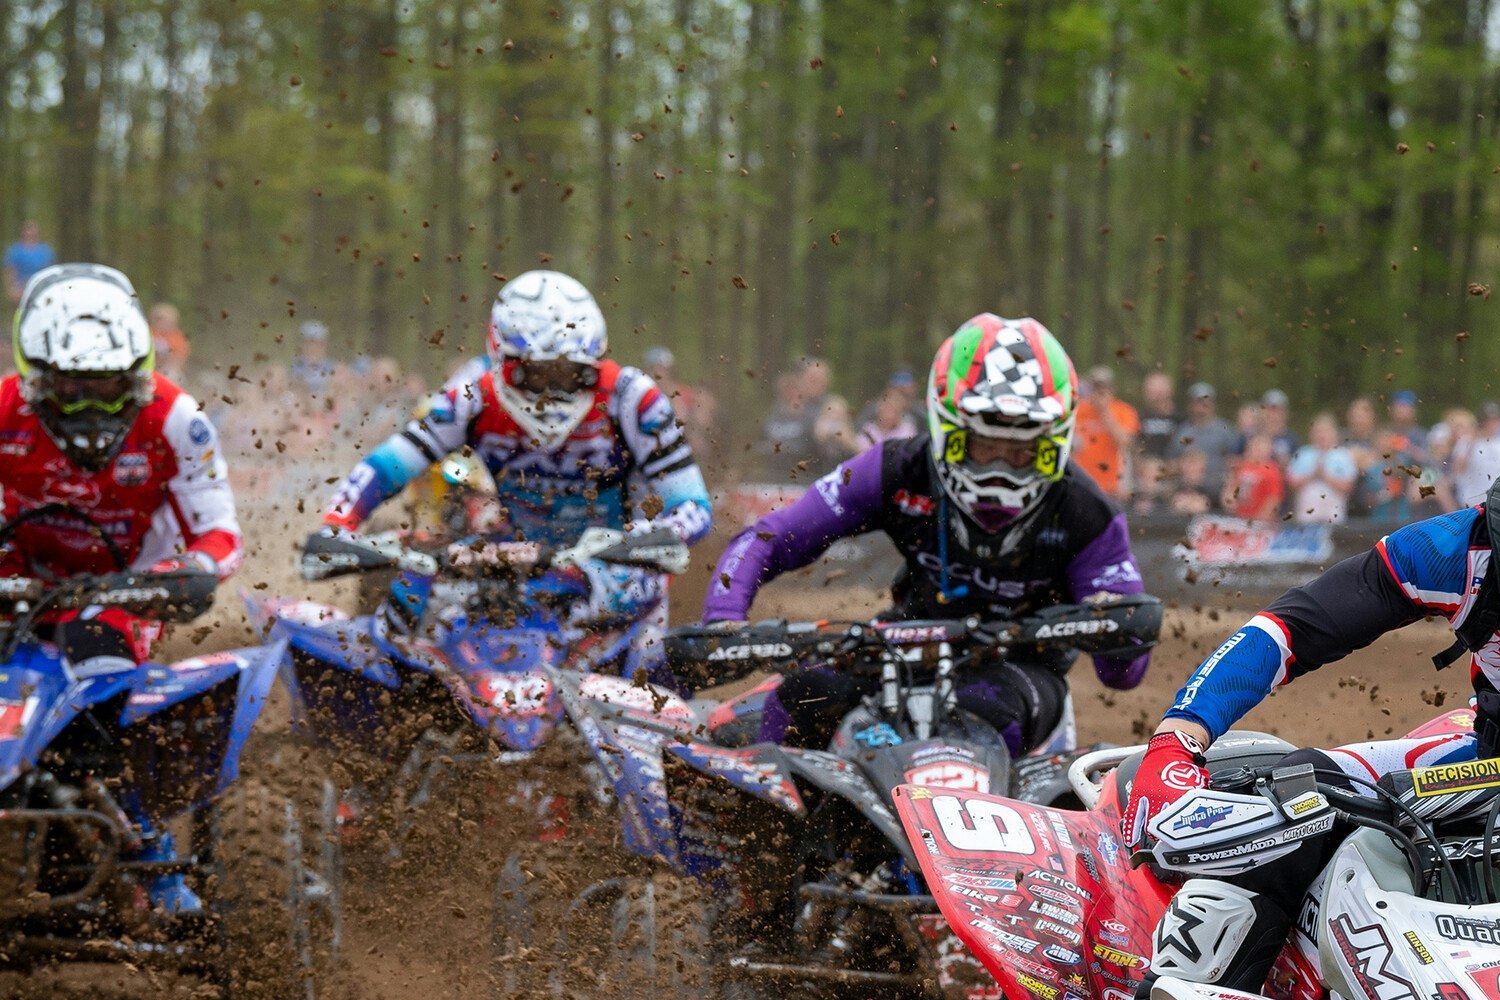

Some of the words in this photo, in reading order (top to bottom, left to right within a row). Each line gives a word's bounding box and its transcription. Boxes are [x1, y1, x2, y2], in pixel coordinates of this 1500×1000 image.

[1424, 781, 1456, 790] Racing
[1458, 776, 1500, 786] Products
[1290, 796, 1318, 811] WORKS
[932, 796, 1036, 855] 9
[1283, 828, 1305, 842] MATTO
[1306, 817, 1330, 836] CYCLE
[920, 828, 941, 857] ATION
[950, 885, 999, 903] Elka
[1028, 868, 1087, 898] ACTION
[1103, 919, 1125, 933] KG
[1094, 945, 1141, 968] STONE
[1407, 931, 1434, 965] HINSON
[1017, 971, 1060, 996] WORKS
